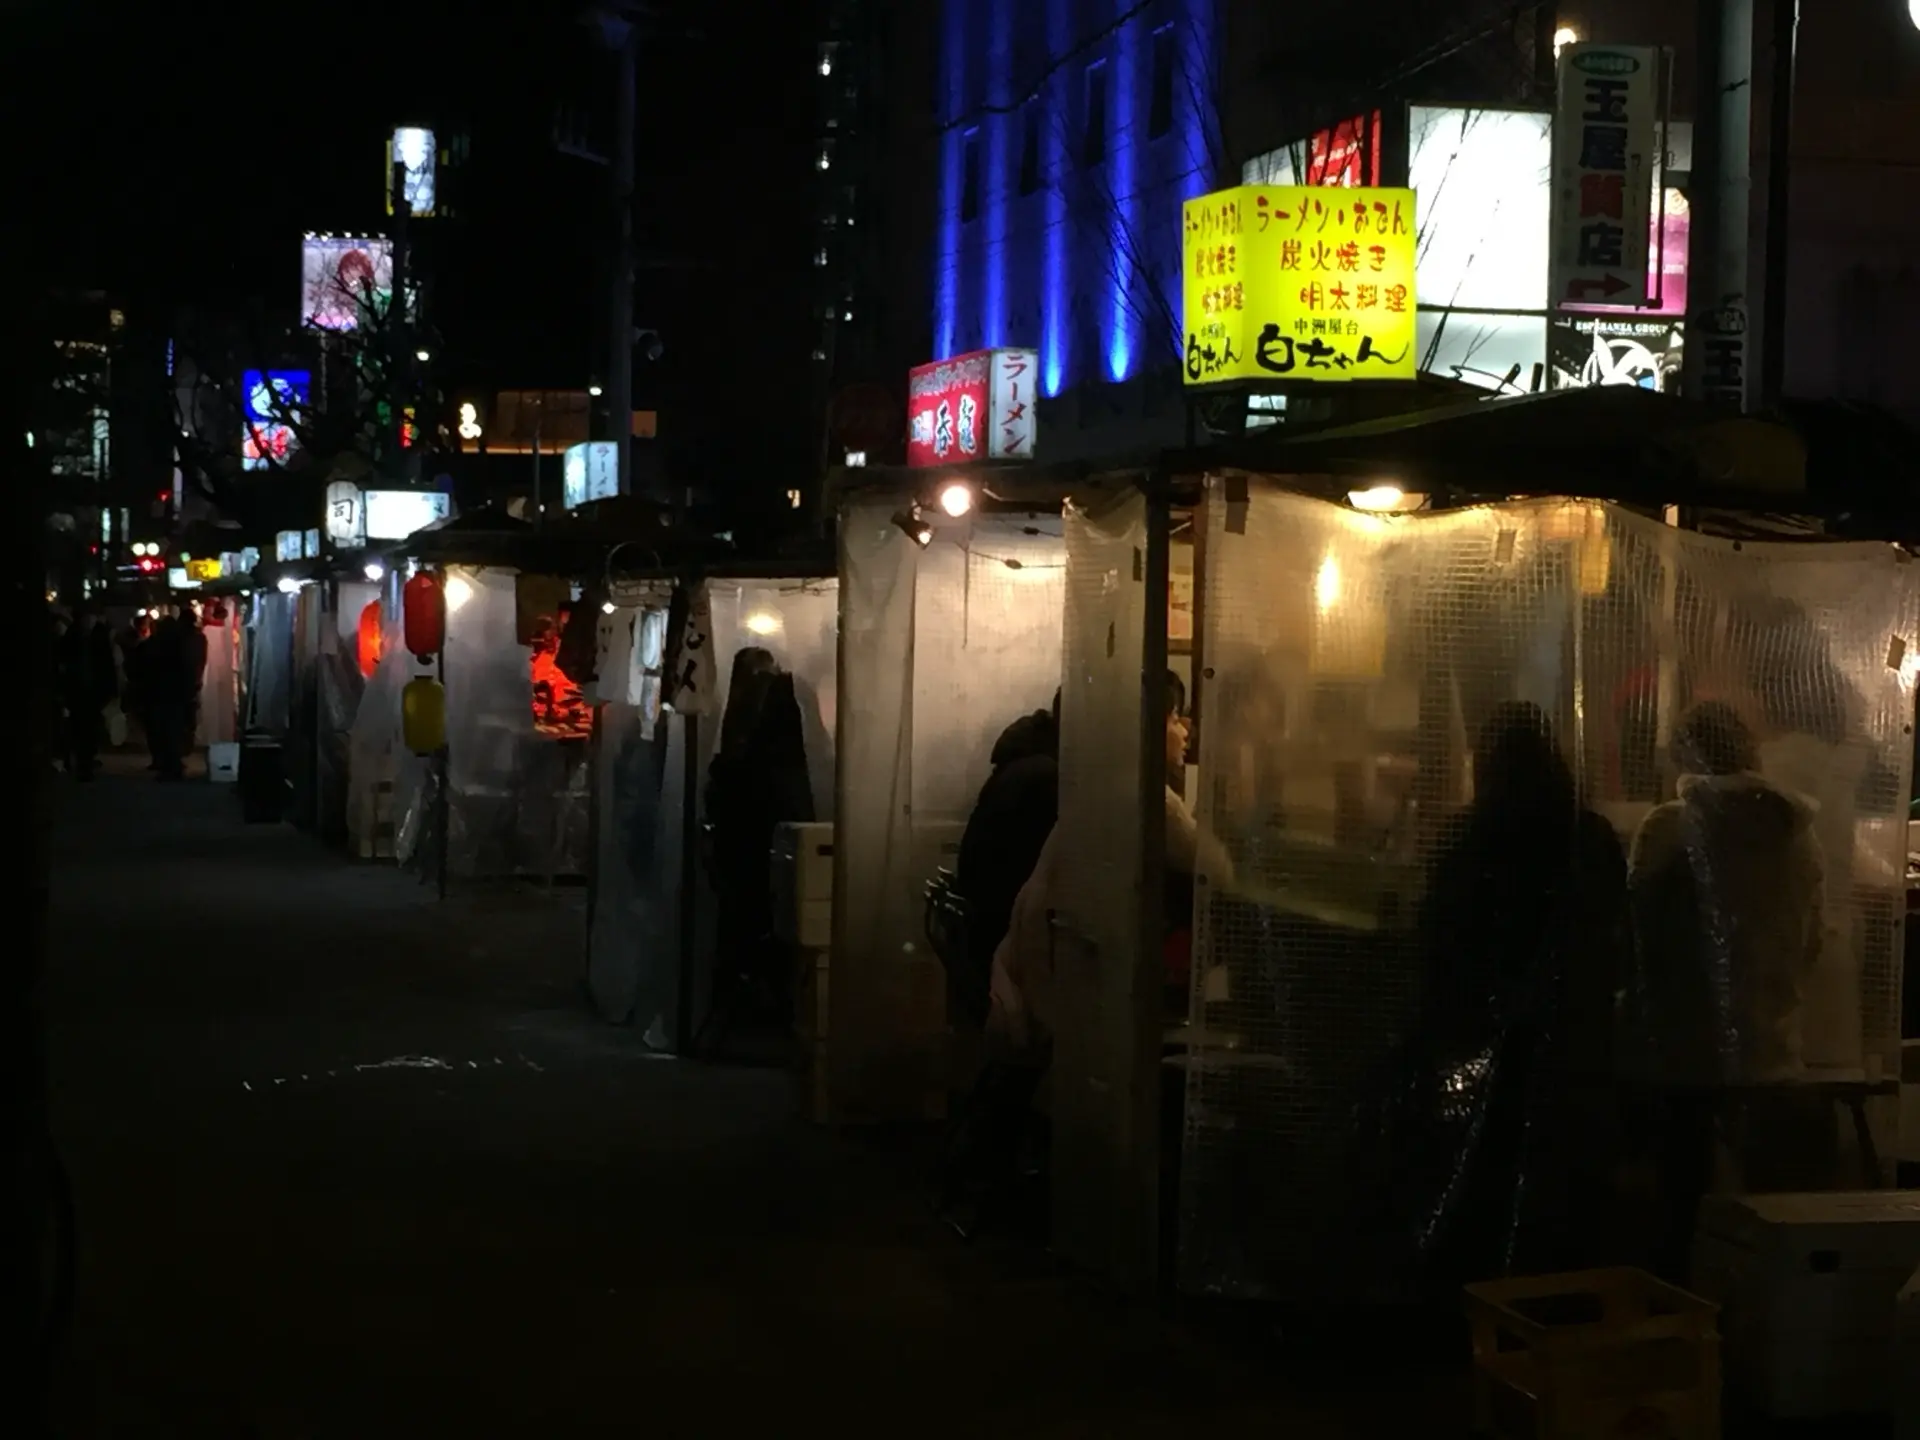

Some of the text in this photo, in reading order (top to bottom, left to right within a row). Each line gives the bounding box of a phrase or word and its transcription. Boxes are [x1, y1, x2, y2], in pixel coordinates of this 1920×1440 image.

[1257, 196, 1408, 235] ラーメン・おでん
[1281, 239, 1386, 272] 炭火焼き
[1300, 281, 1408, 312] 明太料理
[1294, 318, 1359, 335] 中洲屋台
[1575, 320, 1633, 333] ESPRANZA
[1255, 324, 1410, 372] 白ちゃん
[1001, 354, 1028, 454] ラーメン
[332, 499, 355, 524] 司
